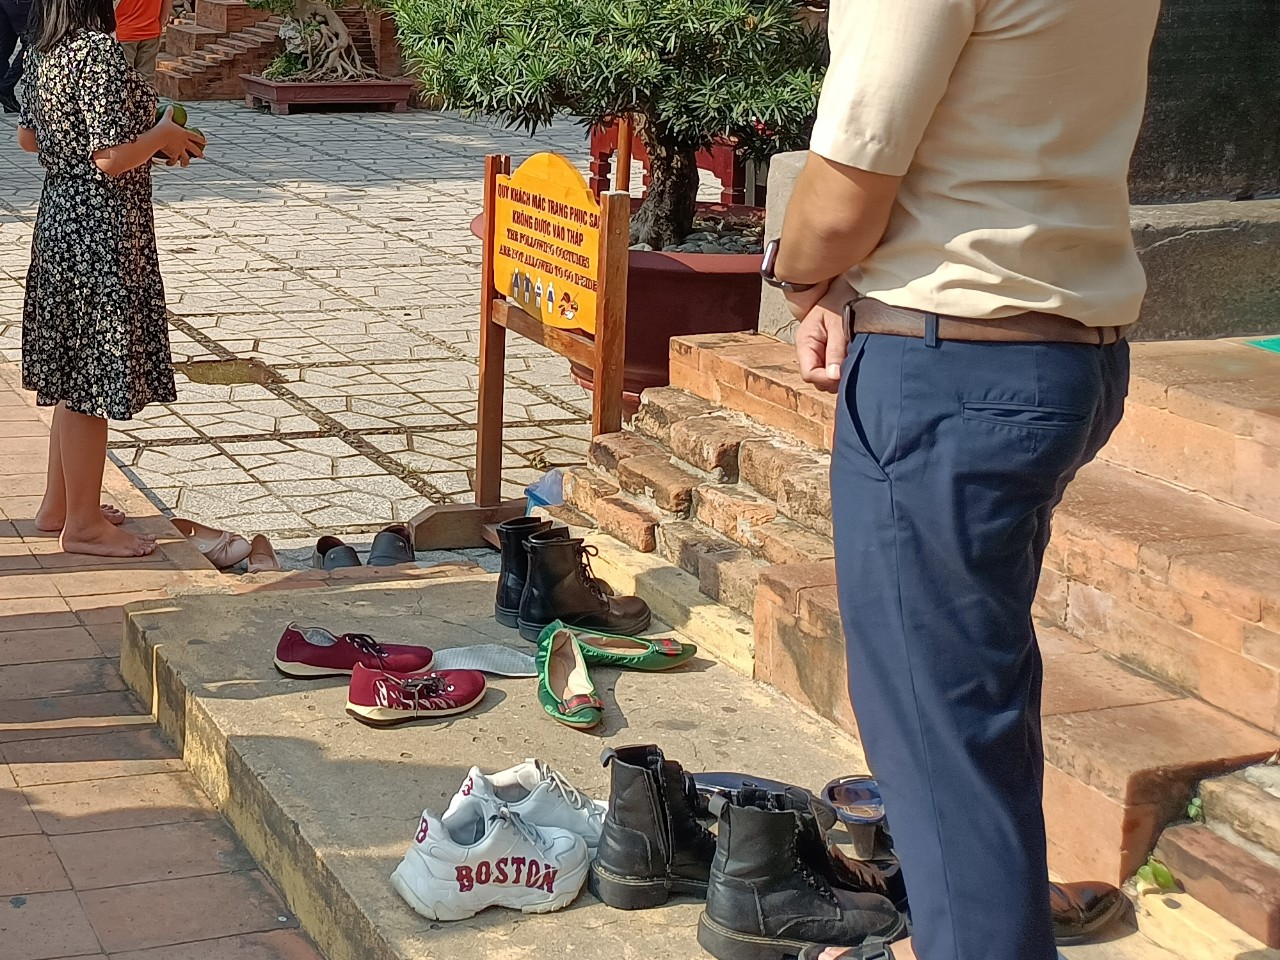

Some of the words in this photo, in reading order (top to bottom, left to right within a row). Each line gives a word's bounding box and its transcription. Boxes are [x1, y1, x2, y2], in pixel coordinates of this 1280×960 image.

[498, 182, 510, 199] QUÝ
[511, 187, 530, 206] KHÁCH
[531, 194, 546, 213] MẶC
[548, 199, 568, 219] TRANG
[570, 207, 588, 227] PHỤC
[507, 228, 518, 242] THE
[519, 233, 555, 256] FOLLOWING
[555, 246, 590, 269] COSTUMES
[512, 209, 533, 230] KHÔNG
[534, 217, 551, 238] ĐƯỢC
[553, 221, 565, 241] VÀO
[567, 228, 584, 247] THÁP
[499, 244, 511, 258] ARE
[511, 248, 524, 262] NOT
[524, 252, 554, 274] ALLOWED
[554, 265, 563, 279] TO
[564, 269, 574, 283] GO
[574, 272, 598, 292] INSIDE
[454, 855, 559, 894] BOSTON
